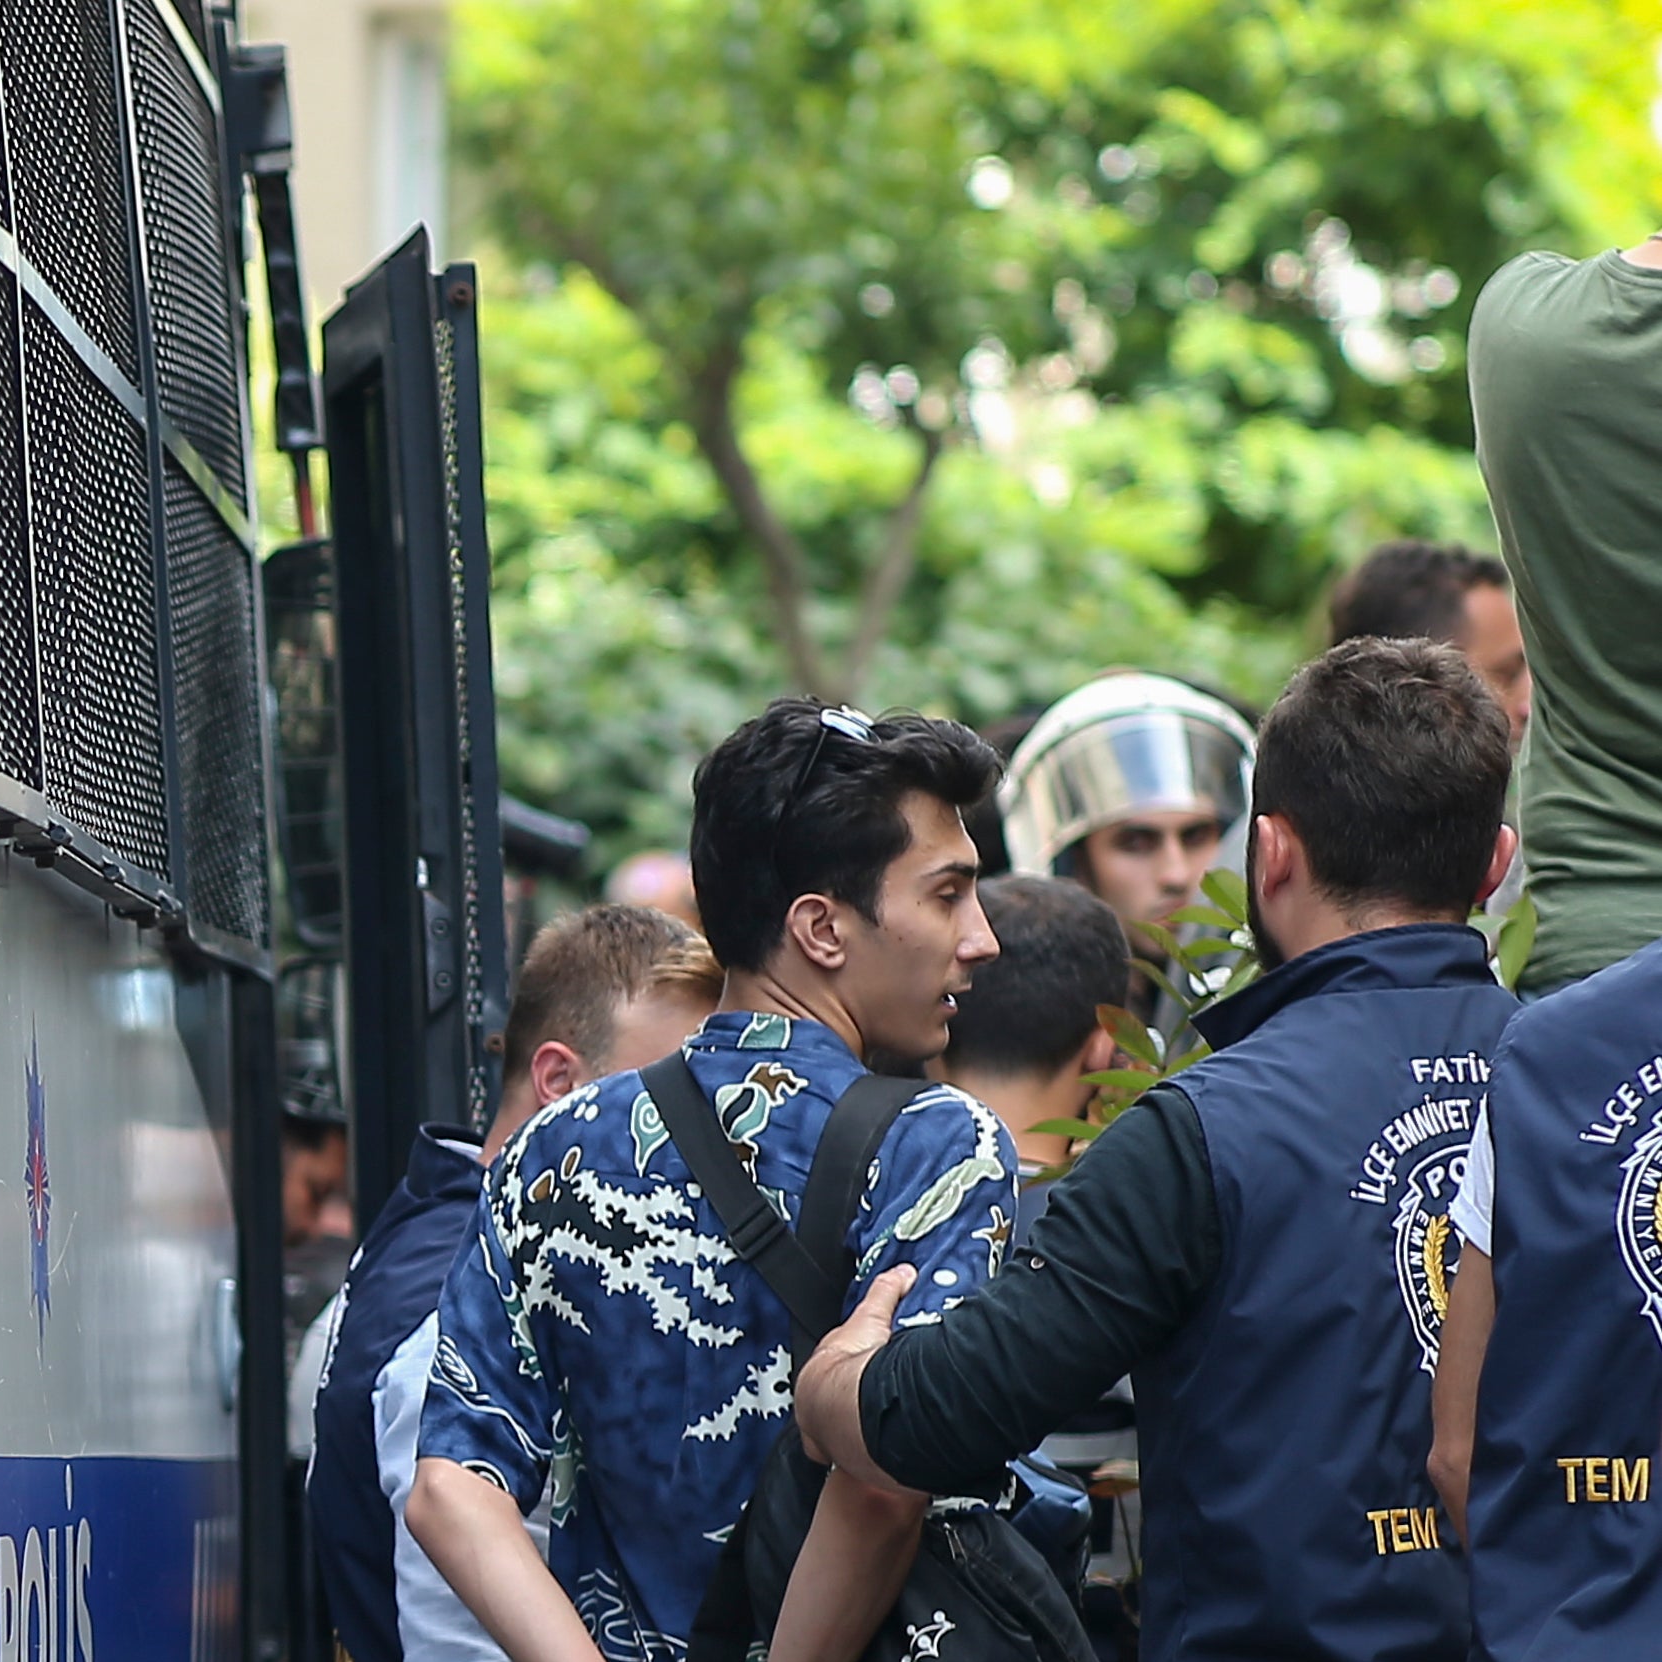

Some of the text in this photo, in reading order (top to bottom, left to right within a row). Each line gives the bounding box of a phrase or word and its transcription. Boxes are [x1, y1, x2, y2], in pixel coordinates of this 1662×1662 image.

[1580, 1083, 1644, 1144] İLÇE
[1350, 1094, 1472, 1204] İLÇE EMNİYET
[1556, 1457, 1651, 1503] TEM
[1366, 1507, 1441, 1555] TEM
